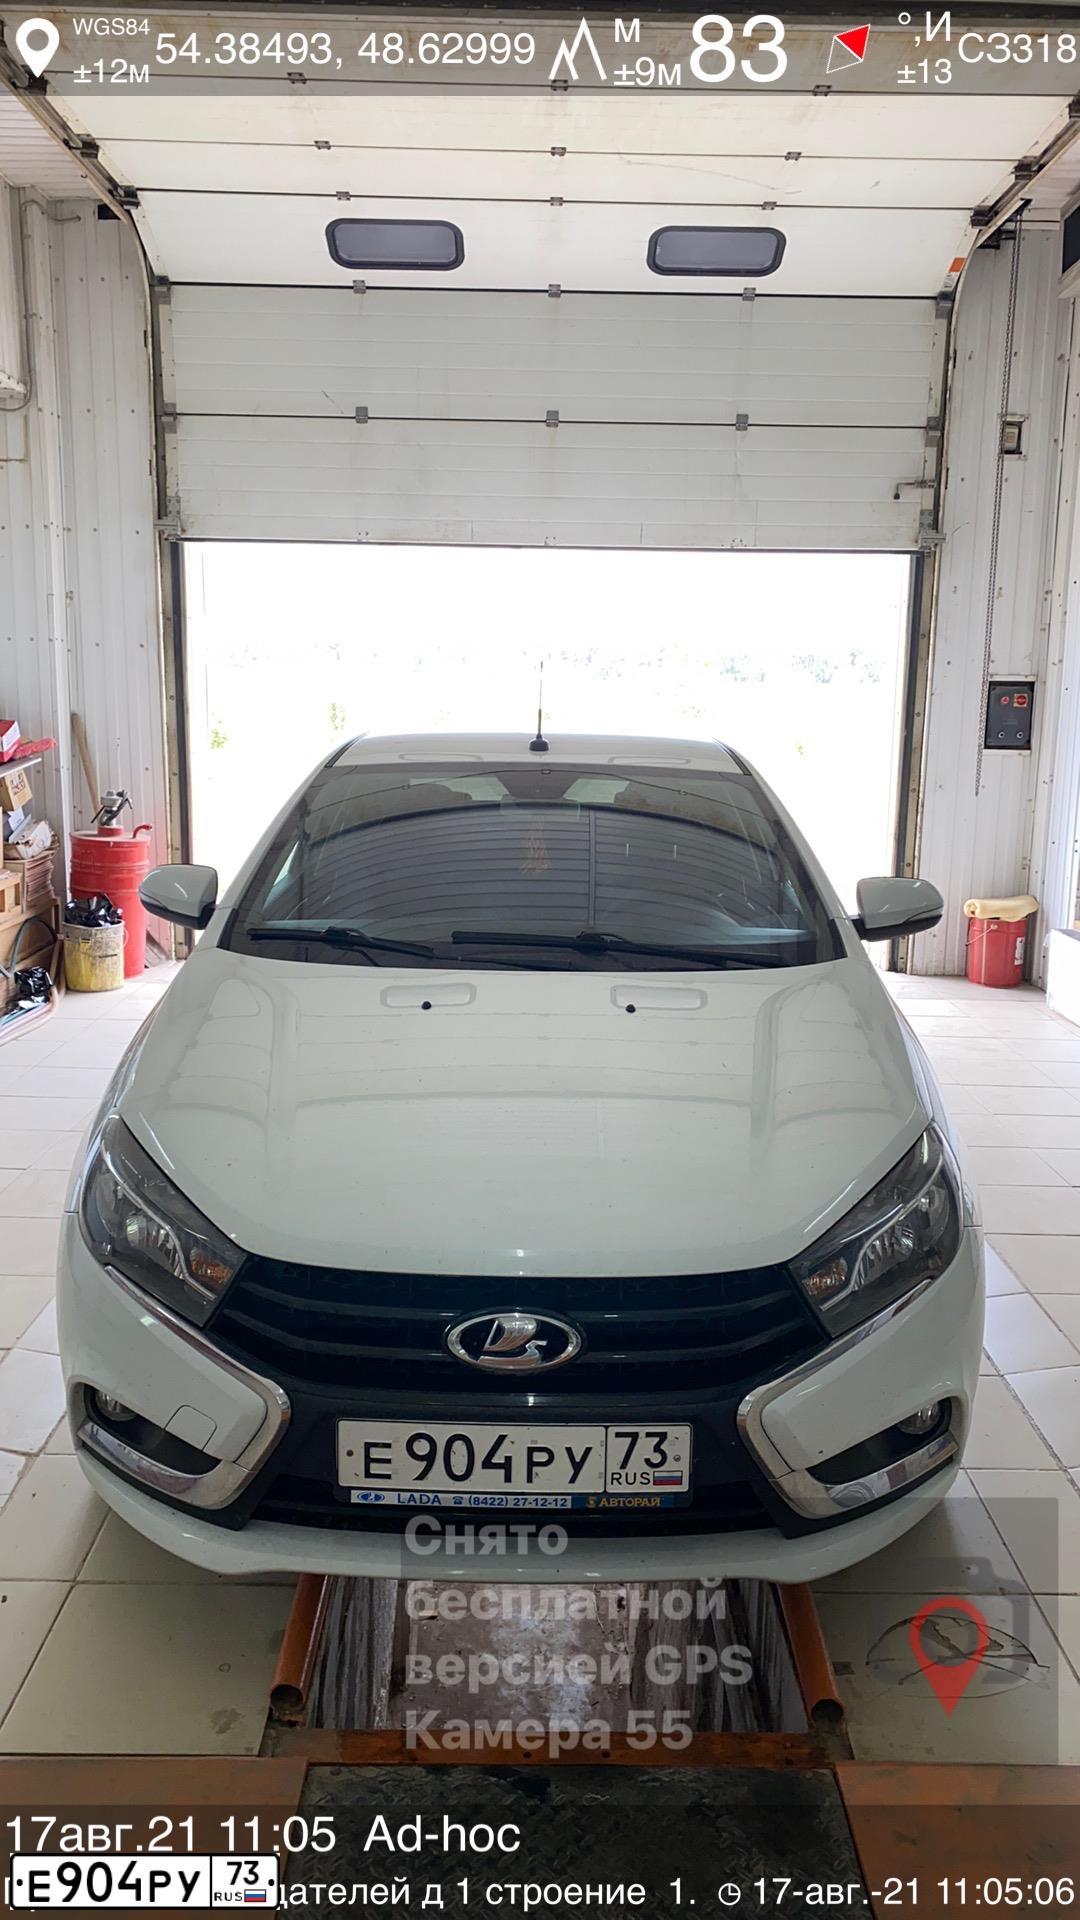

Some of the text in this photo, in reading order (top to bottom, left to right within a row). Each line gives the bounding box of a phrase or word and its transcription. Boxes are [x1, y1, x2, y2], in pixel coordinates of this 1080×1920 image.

[614, 1431, 668, 1470] 73
[610, 1471, 651, 1486] RUS
[397, 1493, 568, 1507] LADA (8422) 27-12-12
[600, 1496, 660, 1507] АВТОРАЙ
